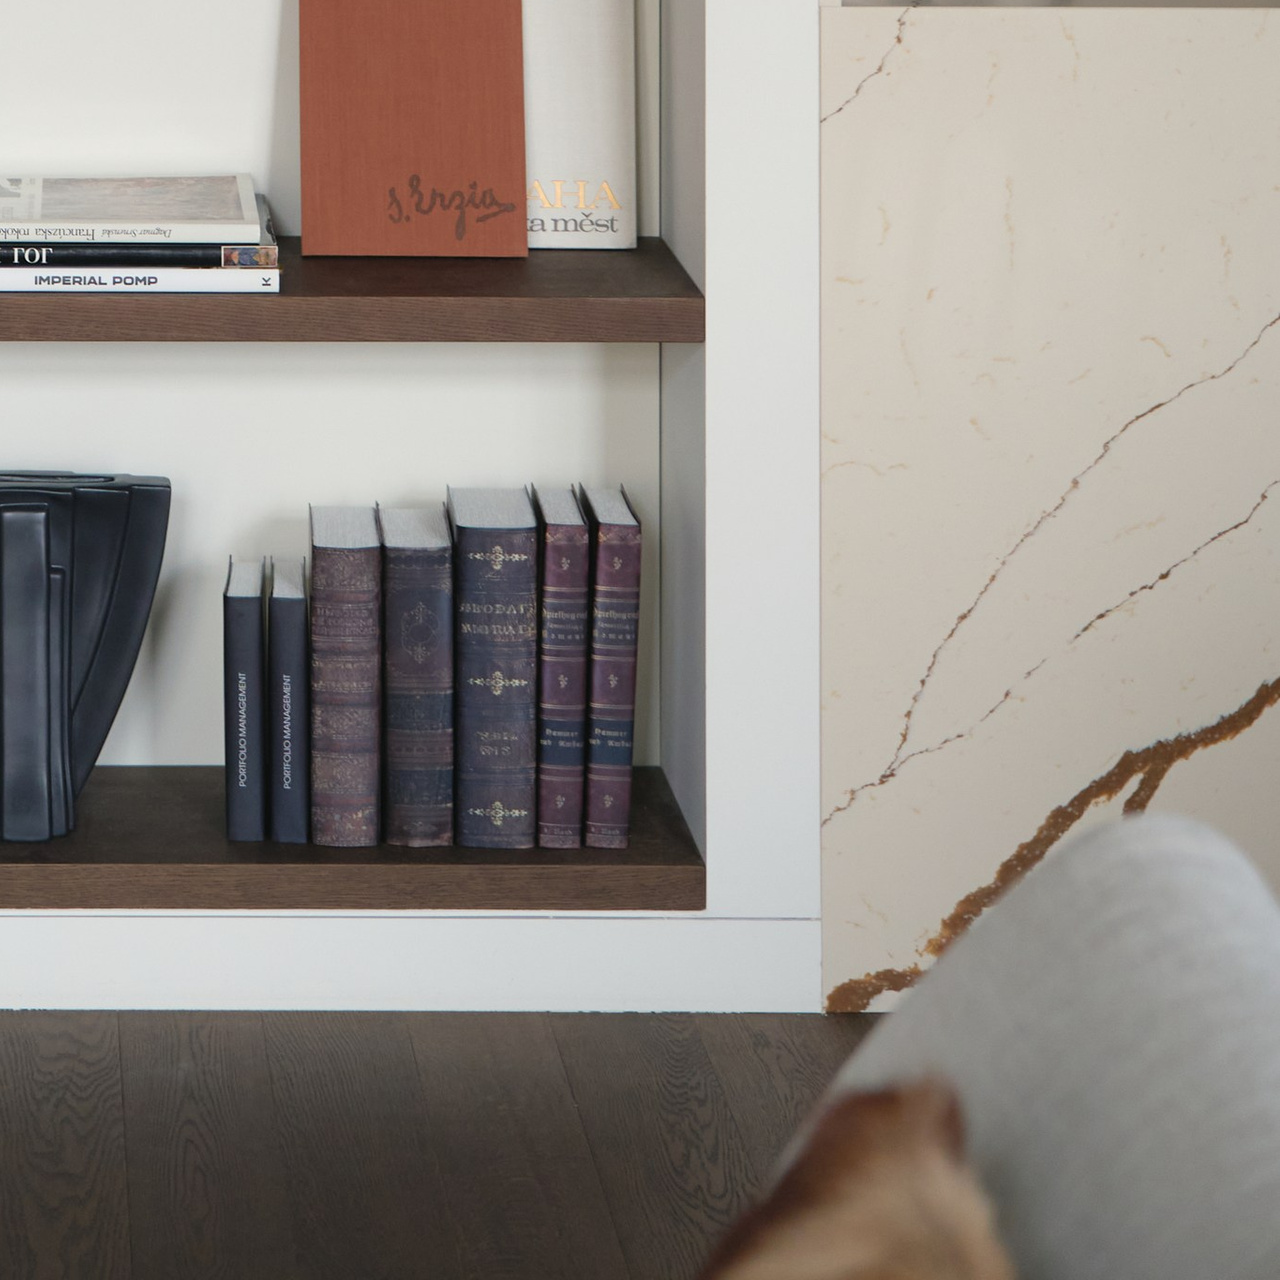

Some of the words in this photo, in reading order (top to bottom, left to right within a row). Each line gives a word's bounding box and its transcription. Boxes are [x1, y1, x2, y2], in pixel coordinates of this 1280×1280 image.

[139, 227, 172, 238] Dagmar
[551, 212, 620, 233] měst
[35, 227, 95, 241] Francúzska
[12, 247, 53, 264] ГОГ
[34, 275, 108, 286] IMPERIAL
[112, 276, 159, 286] POMP
[238, 672, 247, 737] MANAGEMENT
[283, 674, 292, 739] MANAGEMENT
[238, 738, 247, 787] PORTFOLIO
[283, 740, 292, 790] PORTFOLIO
